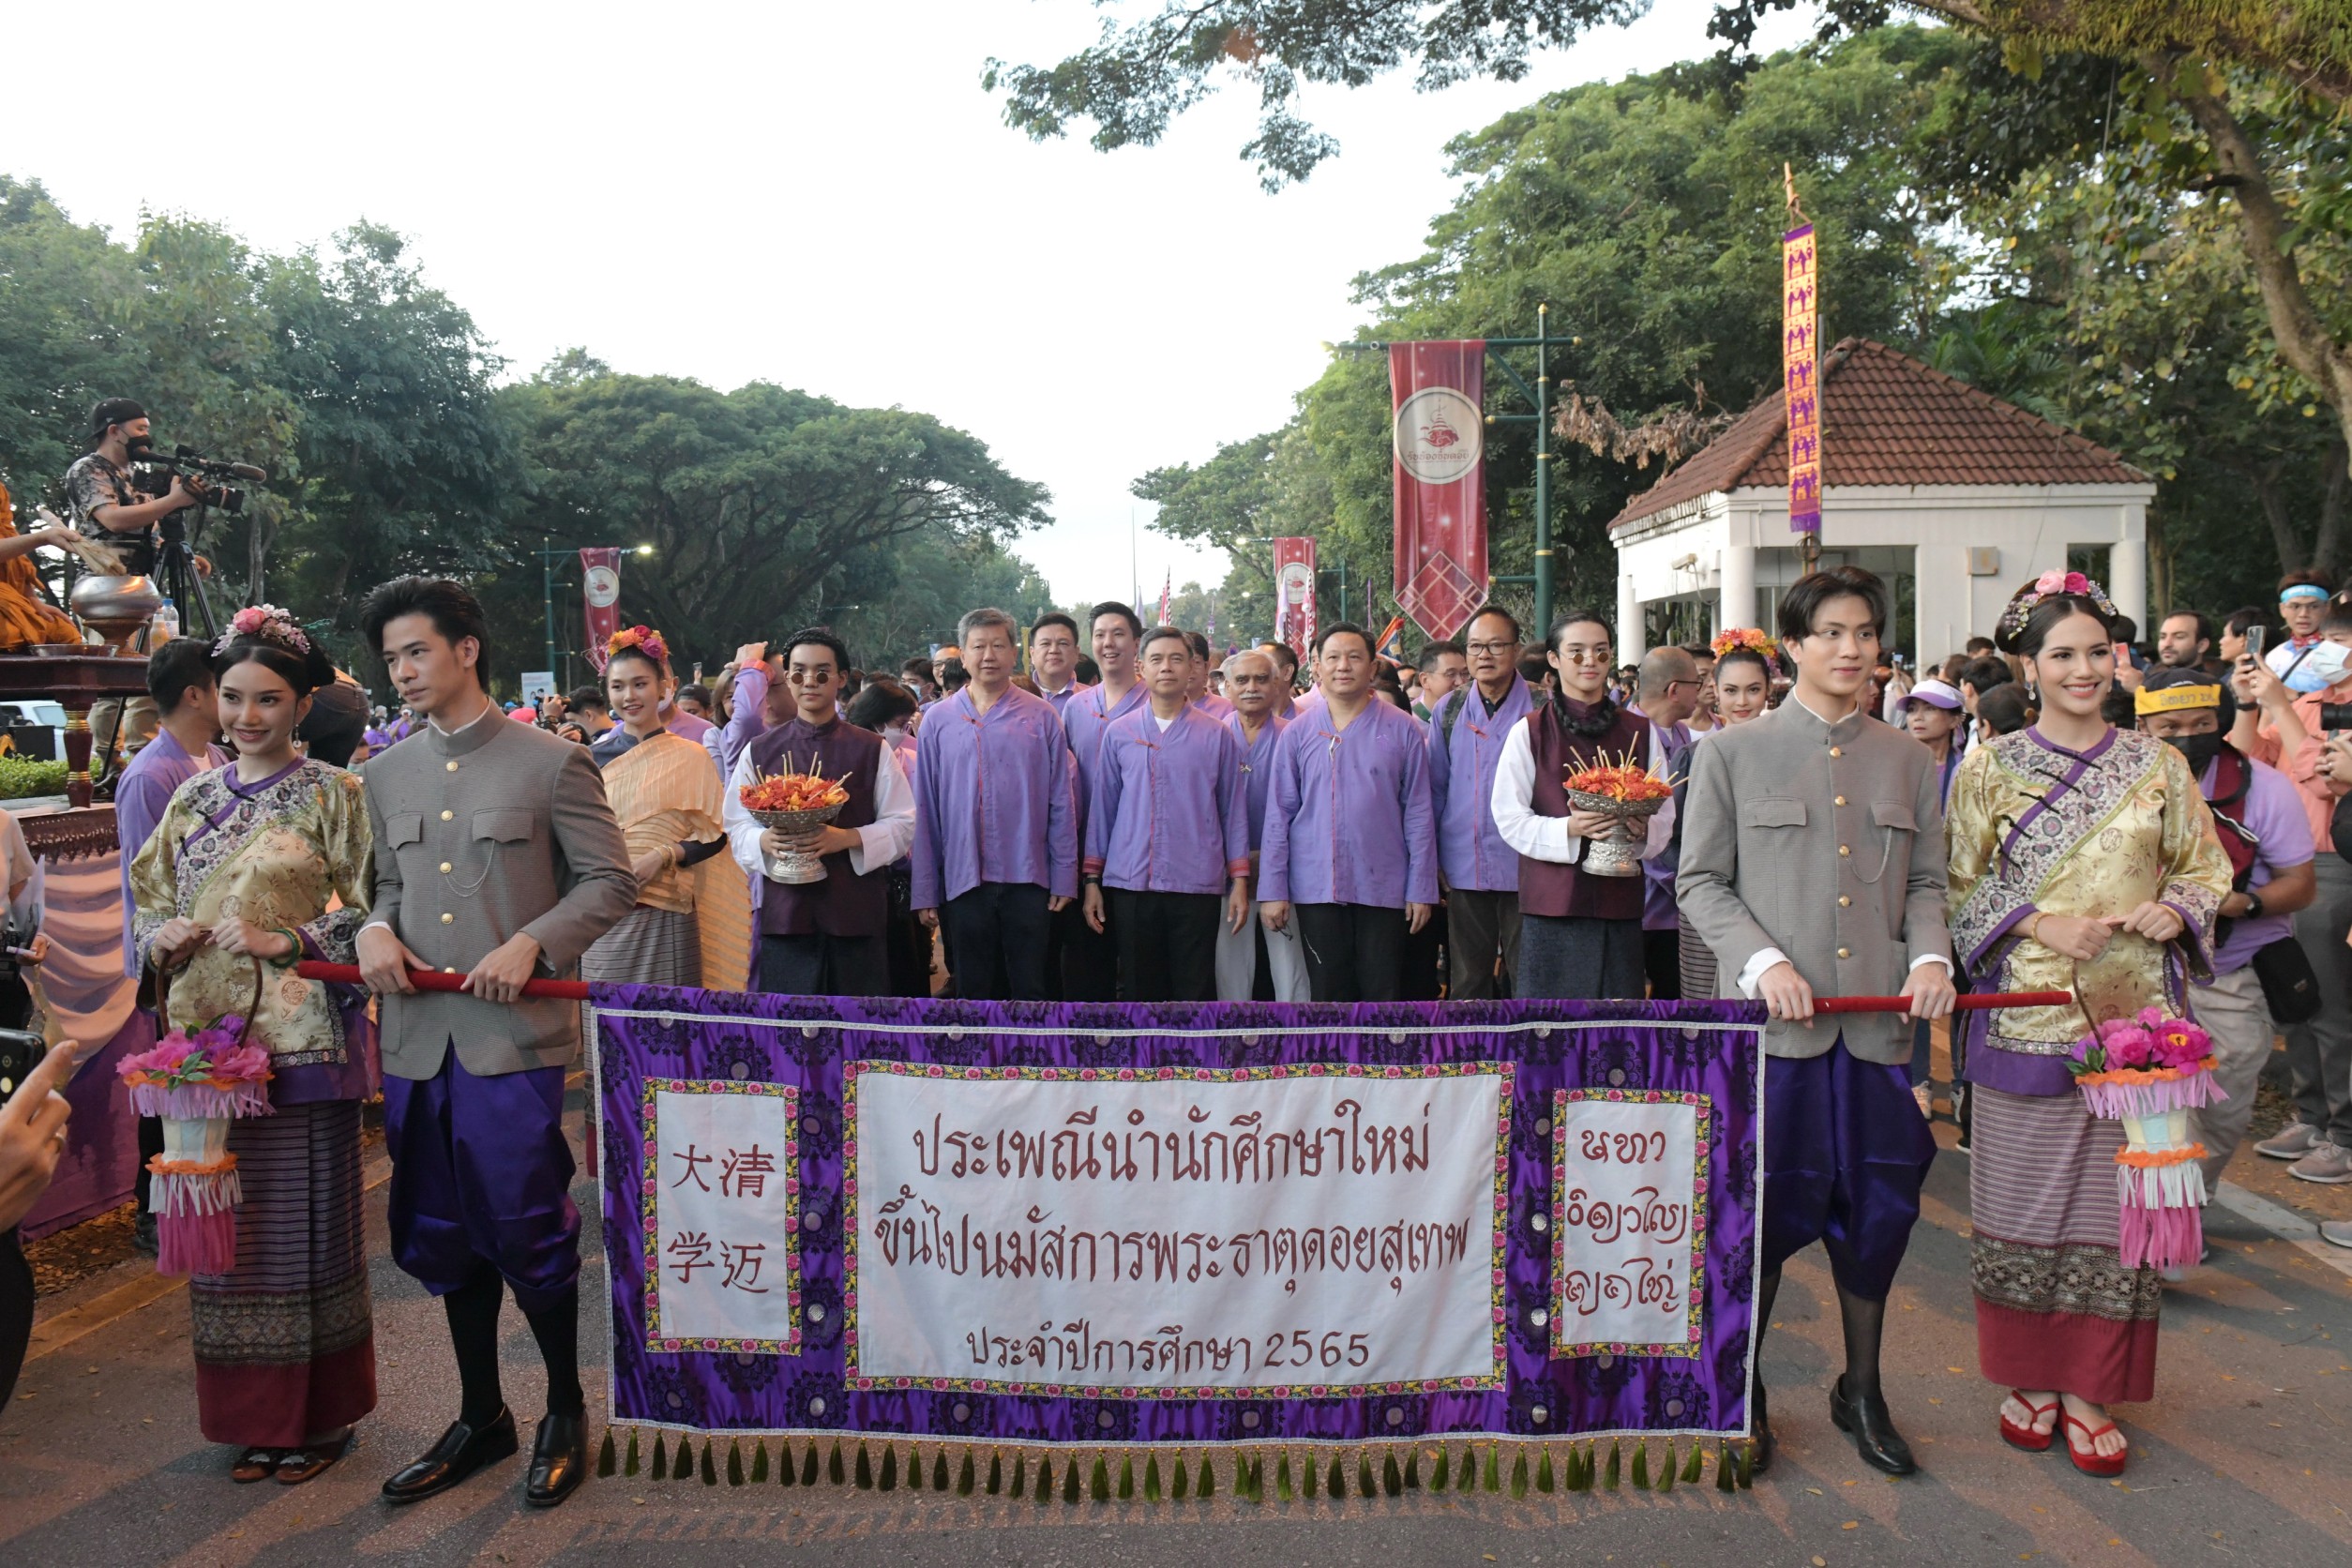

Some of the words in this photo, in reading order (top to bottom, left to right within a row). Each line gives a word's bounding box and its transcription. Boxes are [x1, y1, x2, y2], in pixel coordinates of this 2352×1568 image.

[912, 1099, 1430, 1184] ประเพณีนำนักศึกษาใหม่
[874, 1184, 1471, 1296] ขึ้นไปนมัสการพระธาตุดอยสุเทพ
[967, 1319, 1252, 1373] ประจำปีการศึกษา
[1264, 1329, 1370, 1368] 2565
